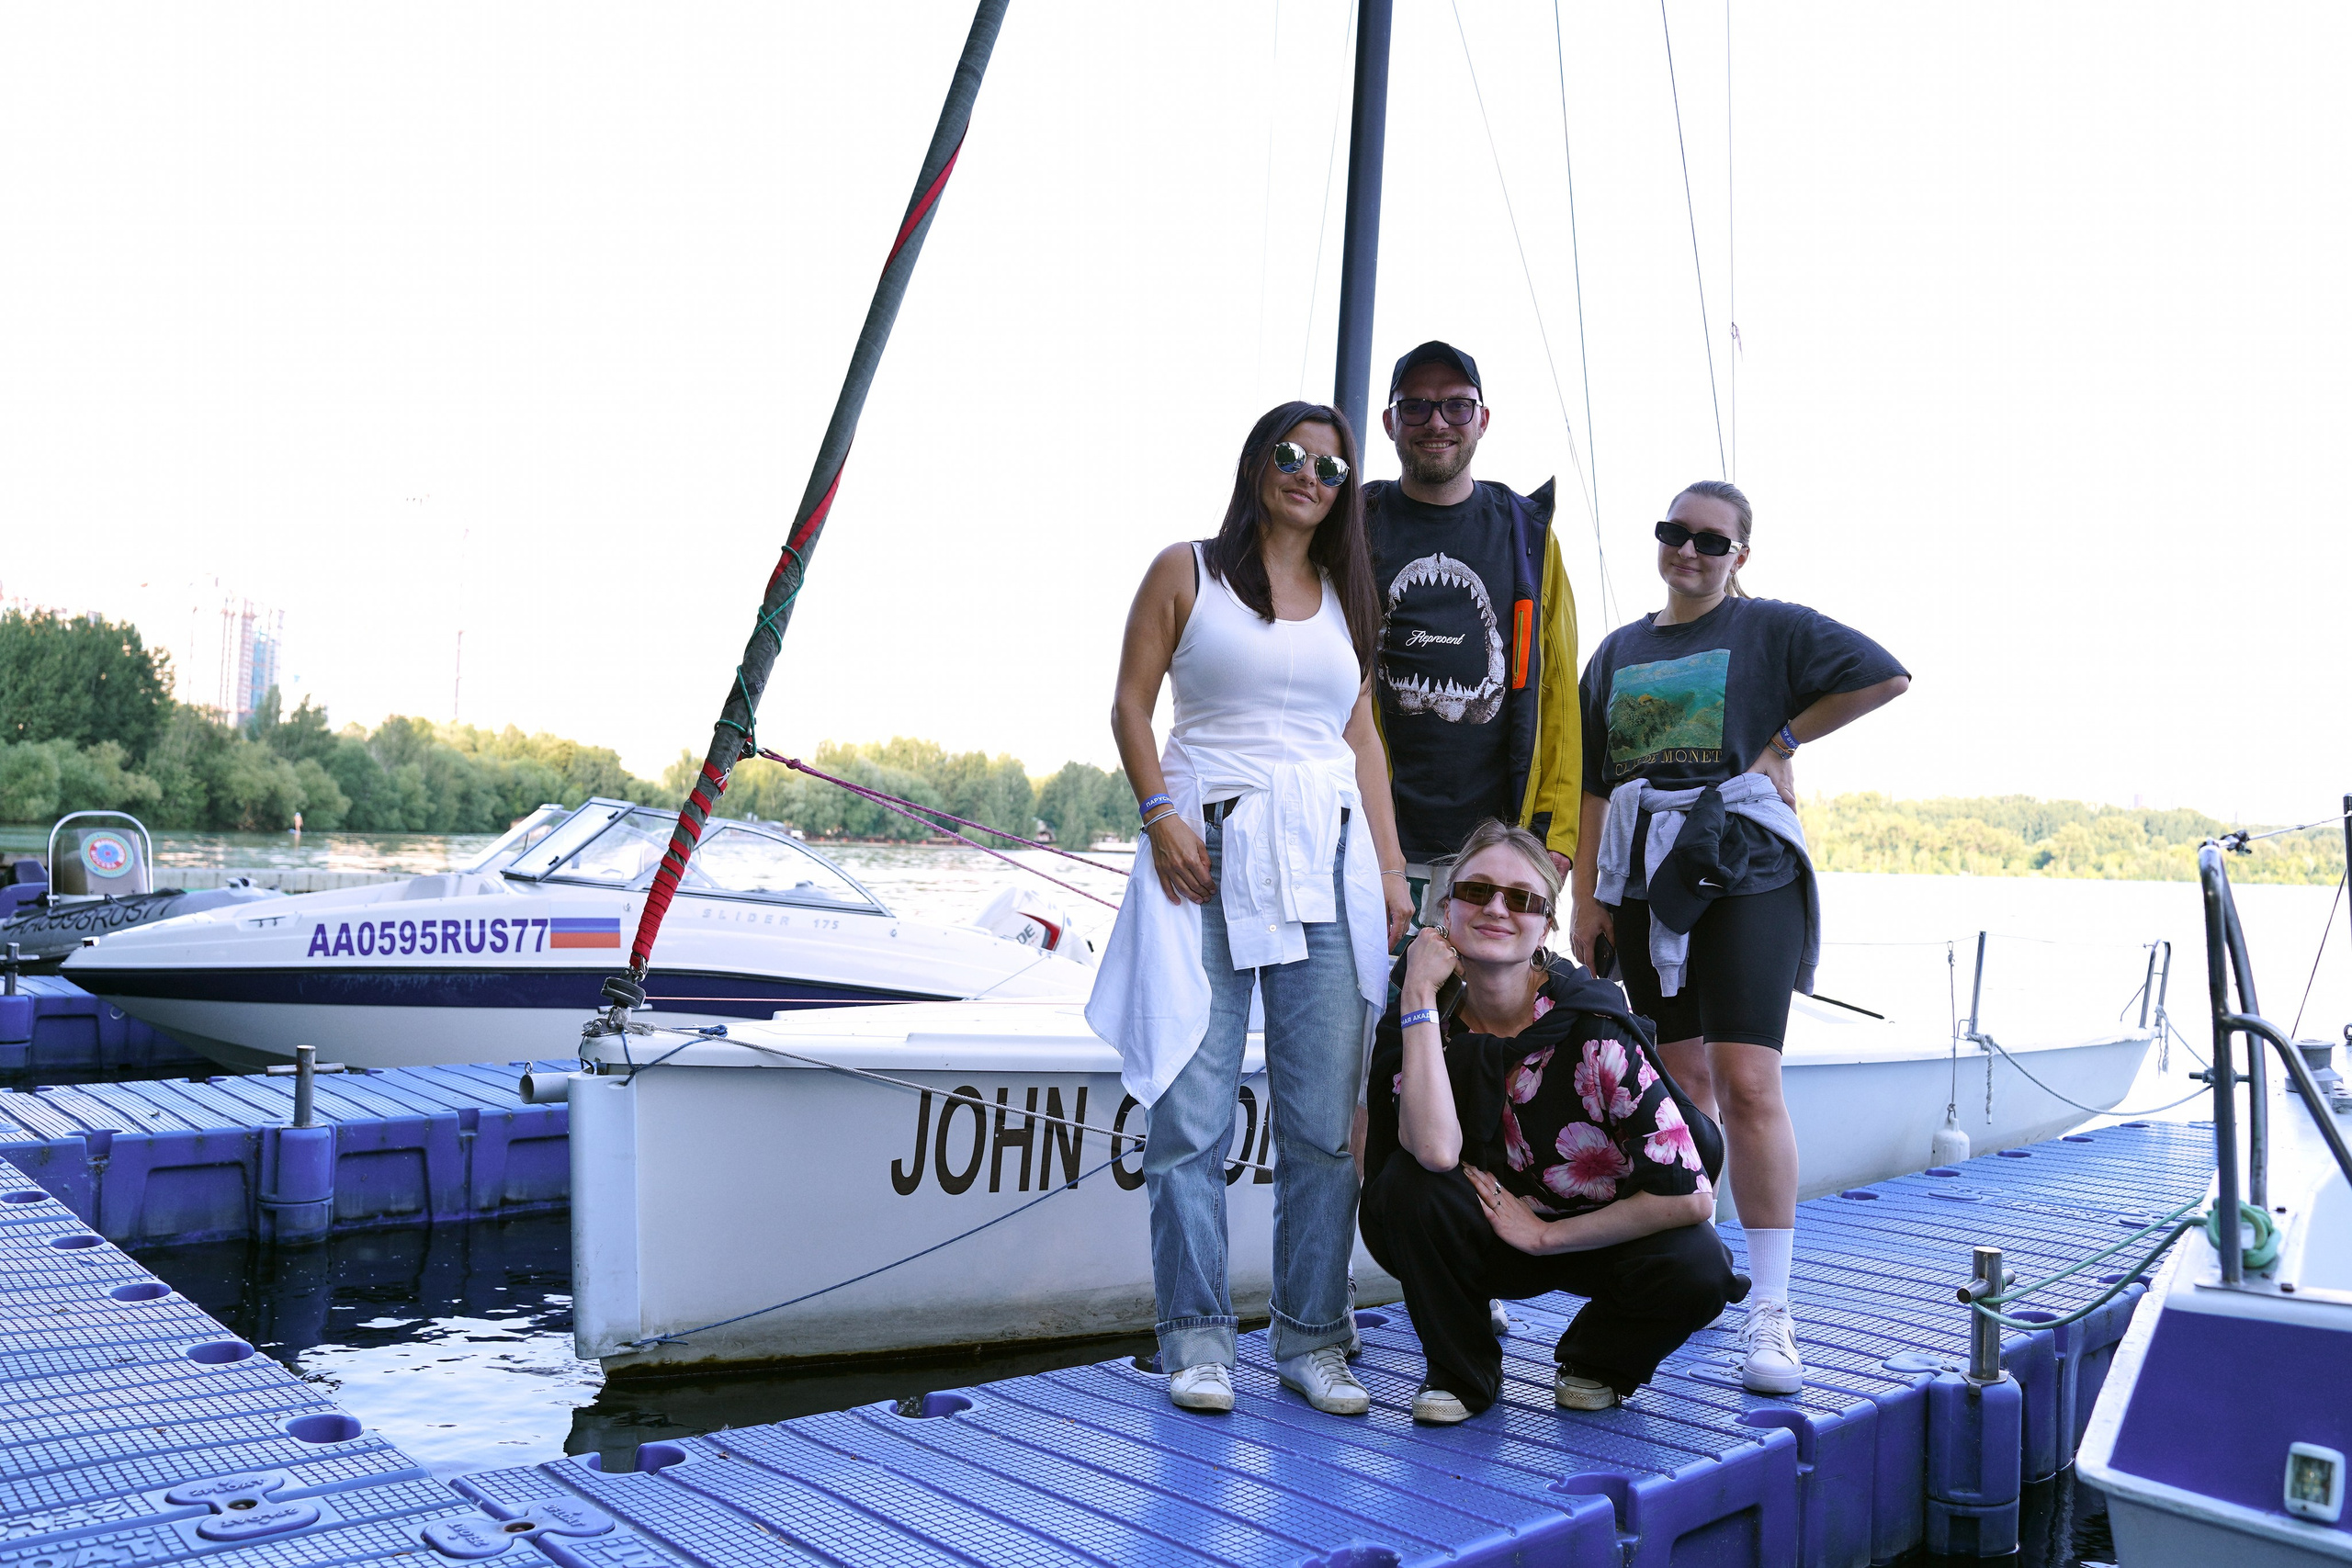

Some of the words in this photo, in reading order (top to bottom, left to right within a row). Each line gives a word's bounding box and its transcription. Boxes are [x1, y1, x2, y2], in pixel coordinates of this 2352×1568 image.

[1405, 629, 1466, 648] Represent
[1661, 750, 1723, 763] MONET
[702, 908, 790, 926] SLIDER
[813, 919, 840, 930] 175
[307, 919, 549, 957] AA0595RUS77
[890, 1085, 1088, 1196] JOHN
